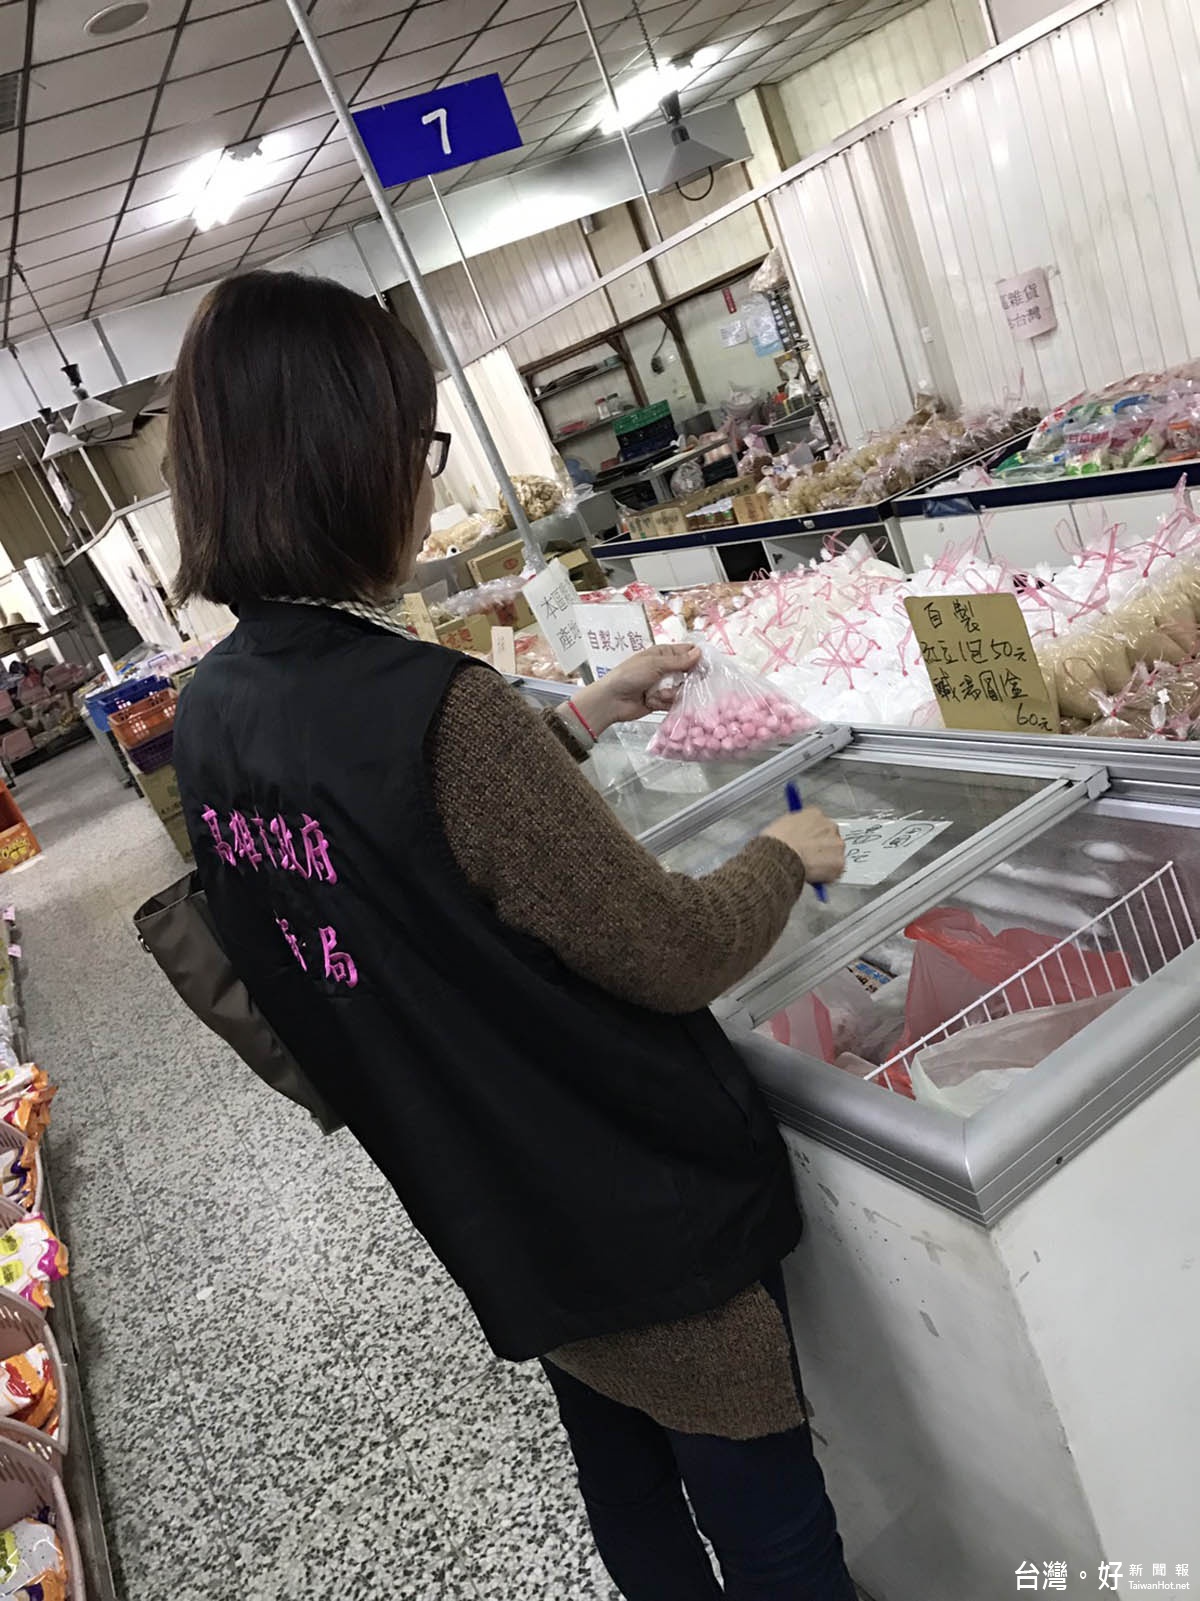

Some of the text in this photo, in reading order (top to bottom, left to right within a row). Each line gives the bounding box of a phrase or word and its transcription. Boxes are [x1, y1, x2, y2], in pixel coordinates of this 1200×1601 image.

[421, 107, 452, 155] 7
[923, 600, 981, 633] 自製
[1016, 702, 1053, 732] 60元
